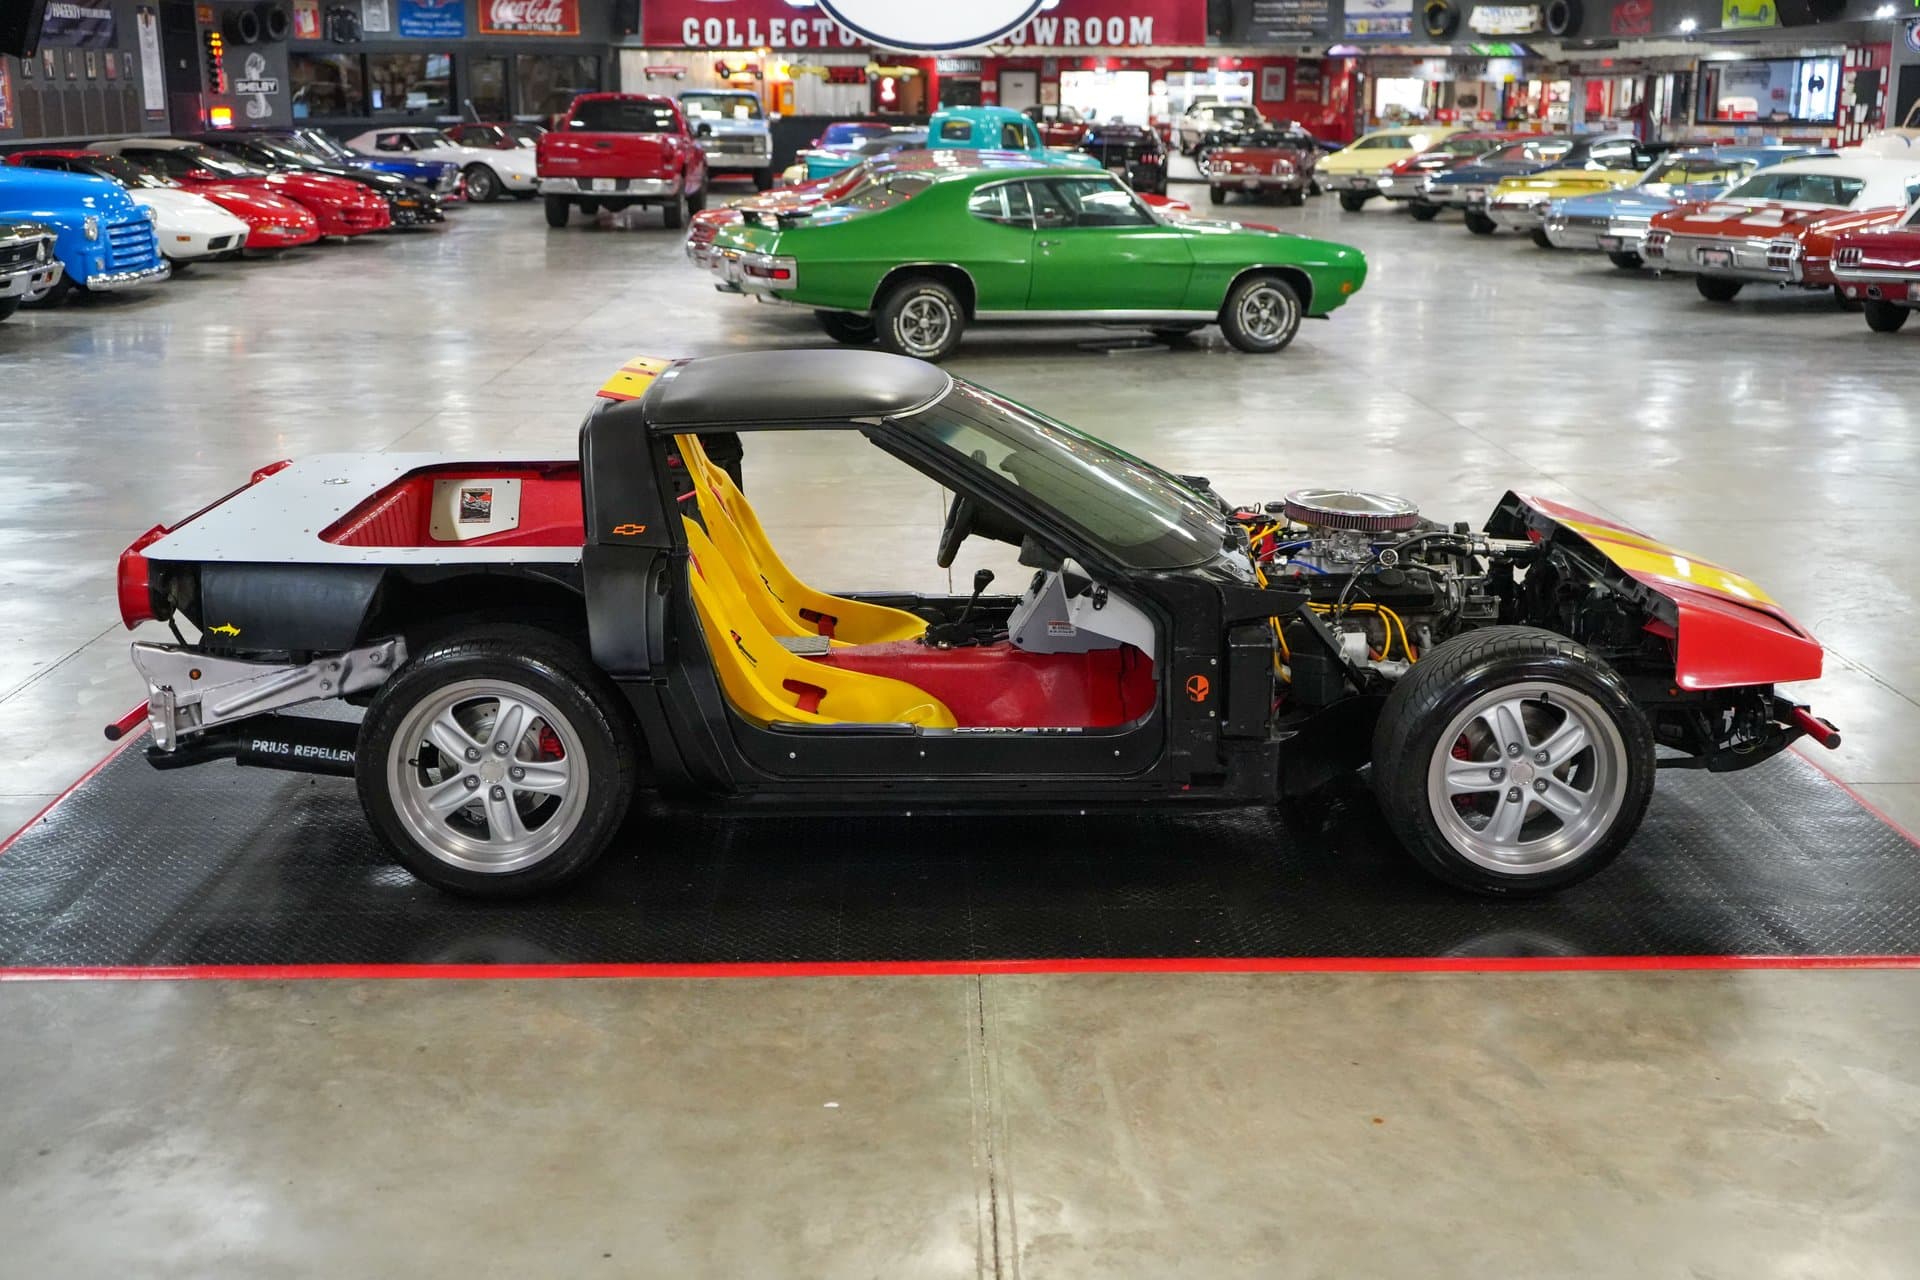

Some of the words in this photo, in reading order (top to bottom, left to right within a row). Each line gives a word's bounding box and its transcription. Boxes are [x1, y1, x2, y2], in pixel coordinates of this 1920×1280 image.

[682, 17, 872, 47] COLLECTO
[992, 15, 1154, 46] OWROOM
[237, 82, 276, 91] SHELBY
[252, 740, 289, 754] PRIUS
[294, 745, 356, 761] REPELLEN
